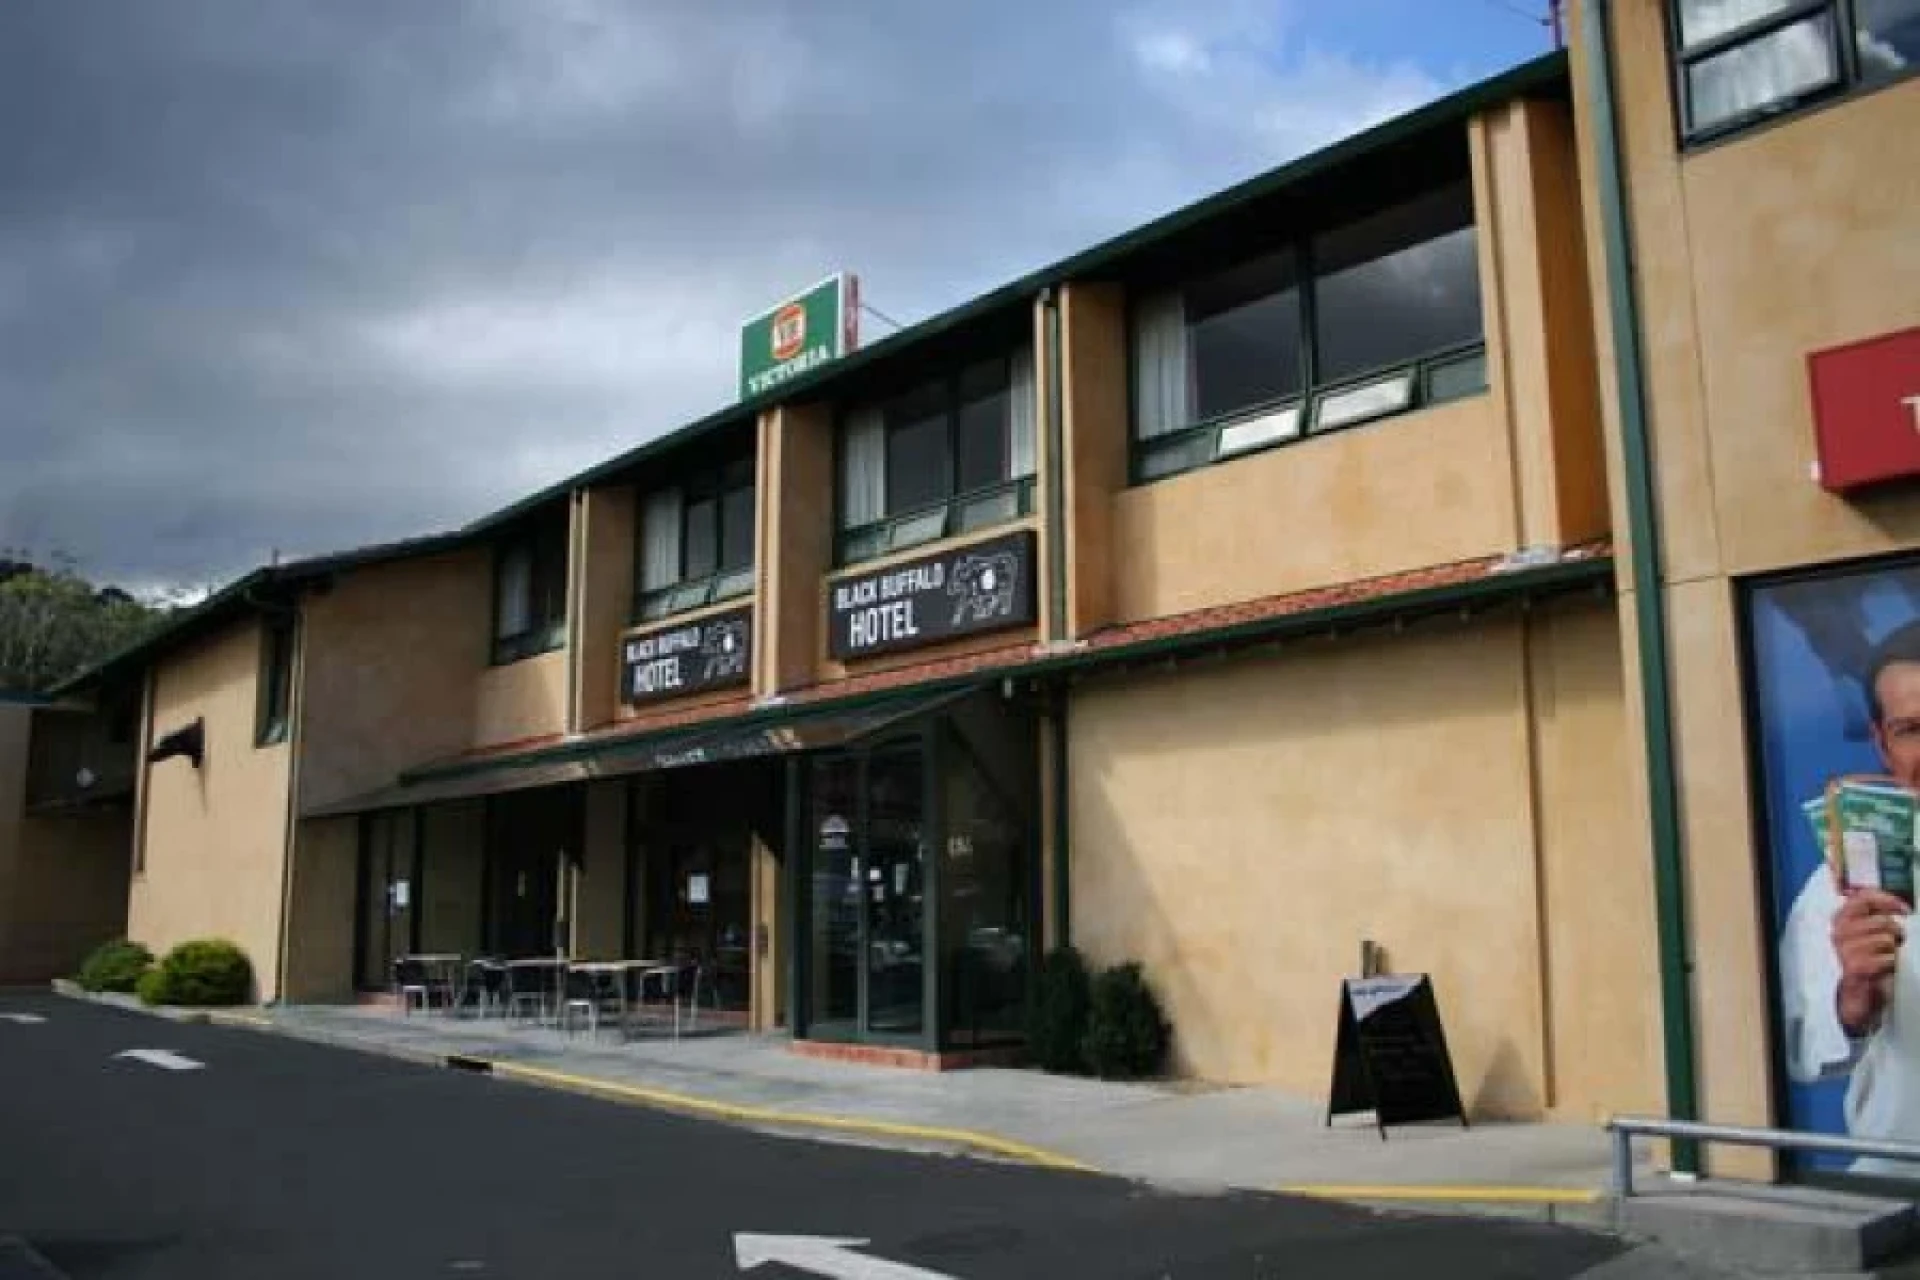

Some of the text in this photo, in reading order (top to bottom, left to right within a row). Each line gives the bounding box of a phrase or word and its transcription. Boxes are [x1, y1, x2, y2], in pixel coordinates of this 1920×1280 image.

[748, 344, 829, 394] VICTORIA
[836, 563, 945, 610] BLACK BUFFALO
[849, 599, 919, 648] HOTEL
[633, 655, 684, 693] HOTEL
